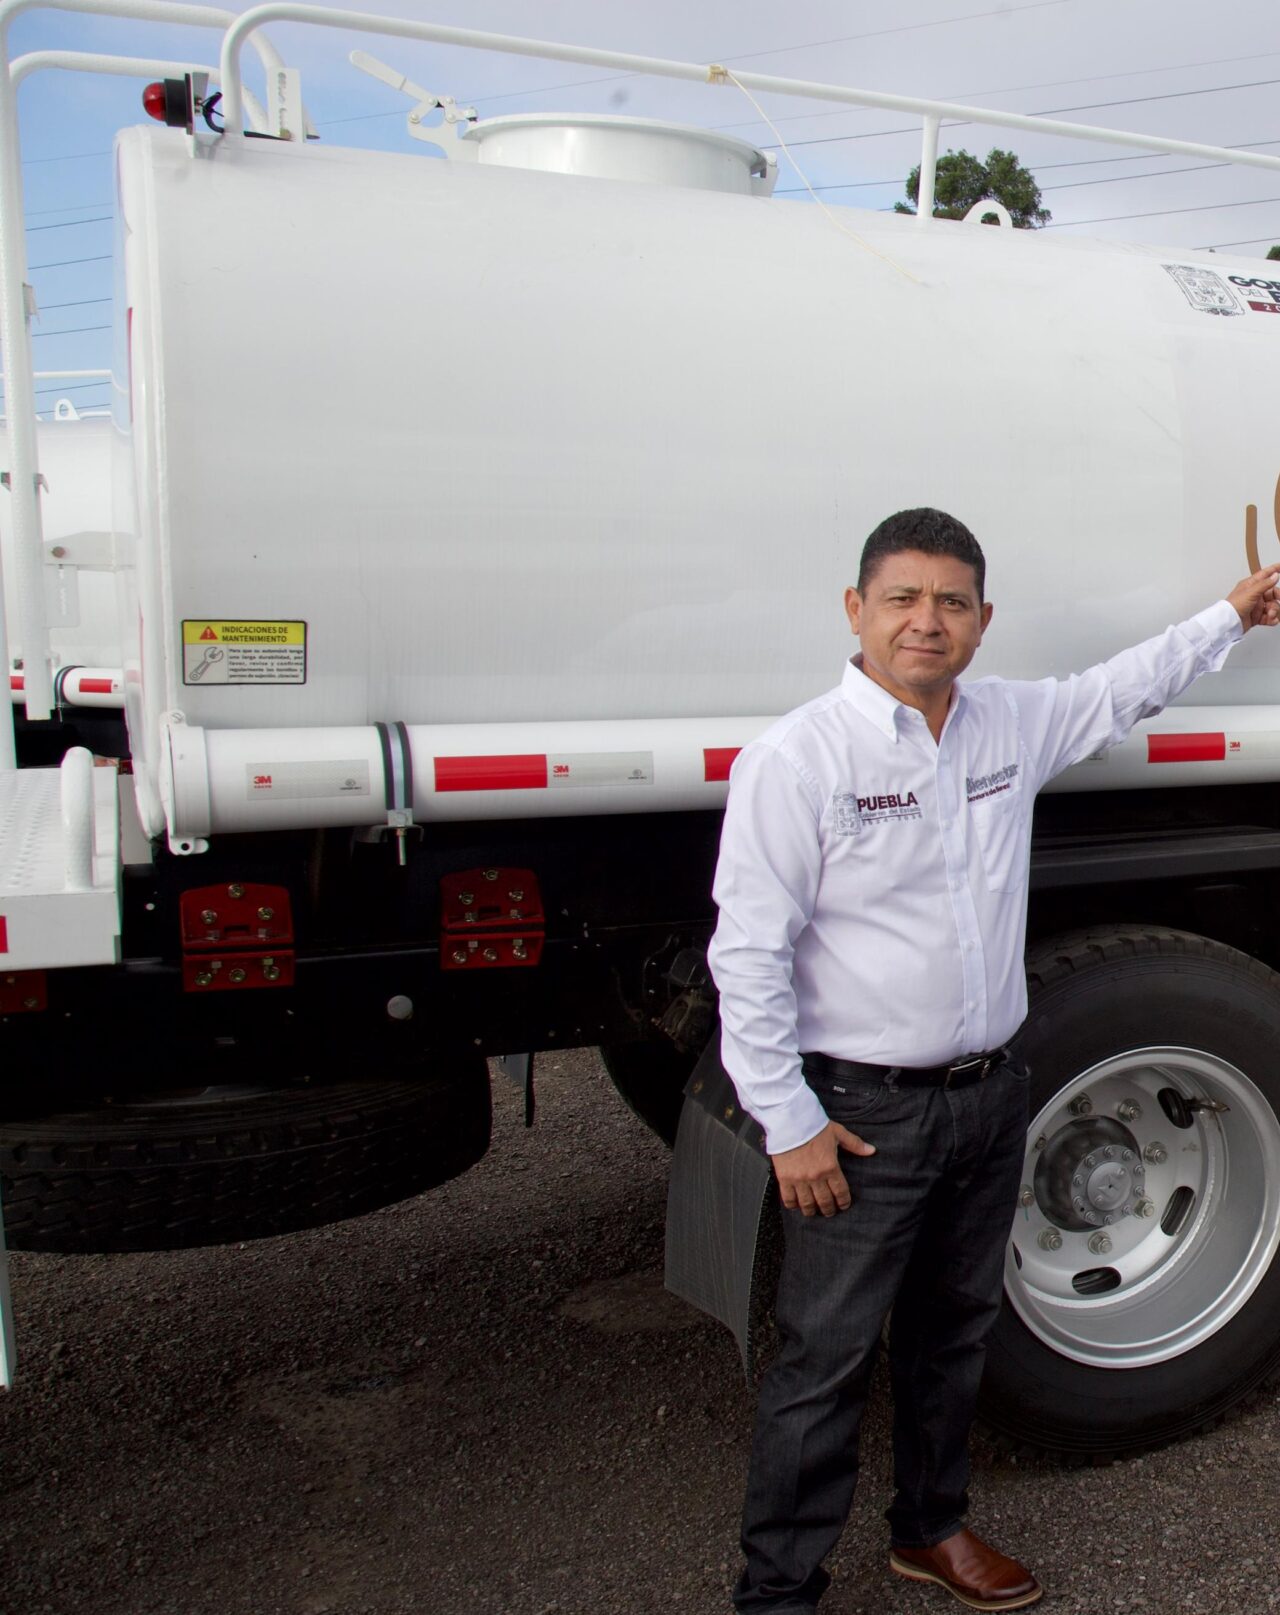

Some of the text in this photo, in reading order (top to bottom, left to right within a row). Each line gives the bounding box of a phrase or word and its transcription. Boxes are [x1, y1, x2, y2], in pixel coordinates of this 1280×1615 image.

[1237, 288, 1269, 298] DEL
[221, 626, 288, 634] INDICACIONES DE
[221, 635, 288, 643] MANTENIMIENTO
[553, 765, 569, 773] 3M
[253, 775, 272, 784] 3M
[857, 792, 918, 812] PUEBLA
